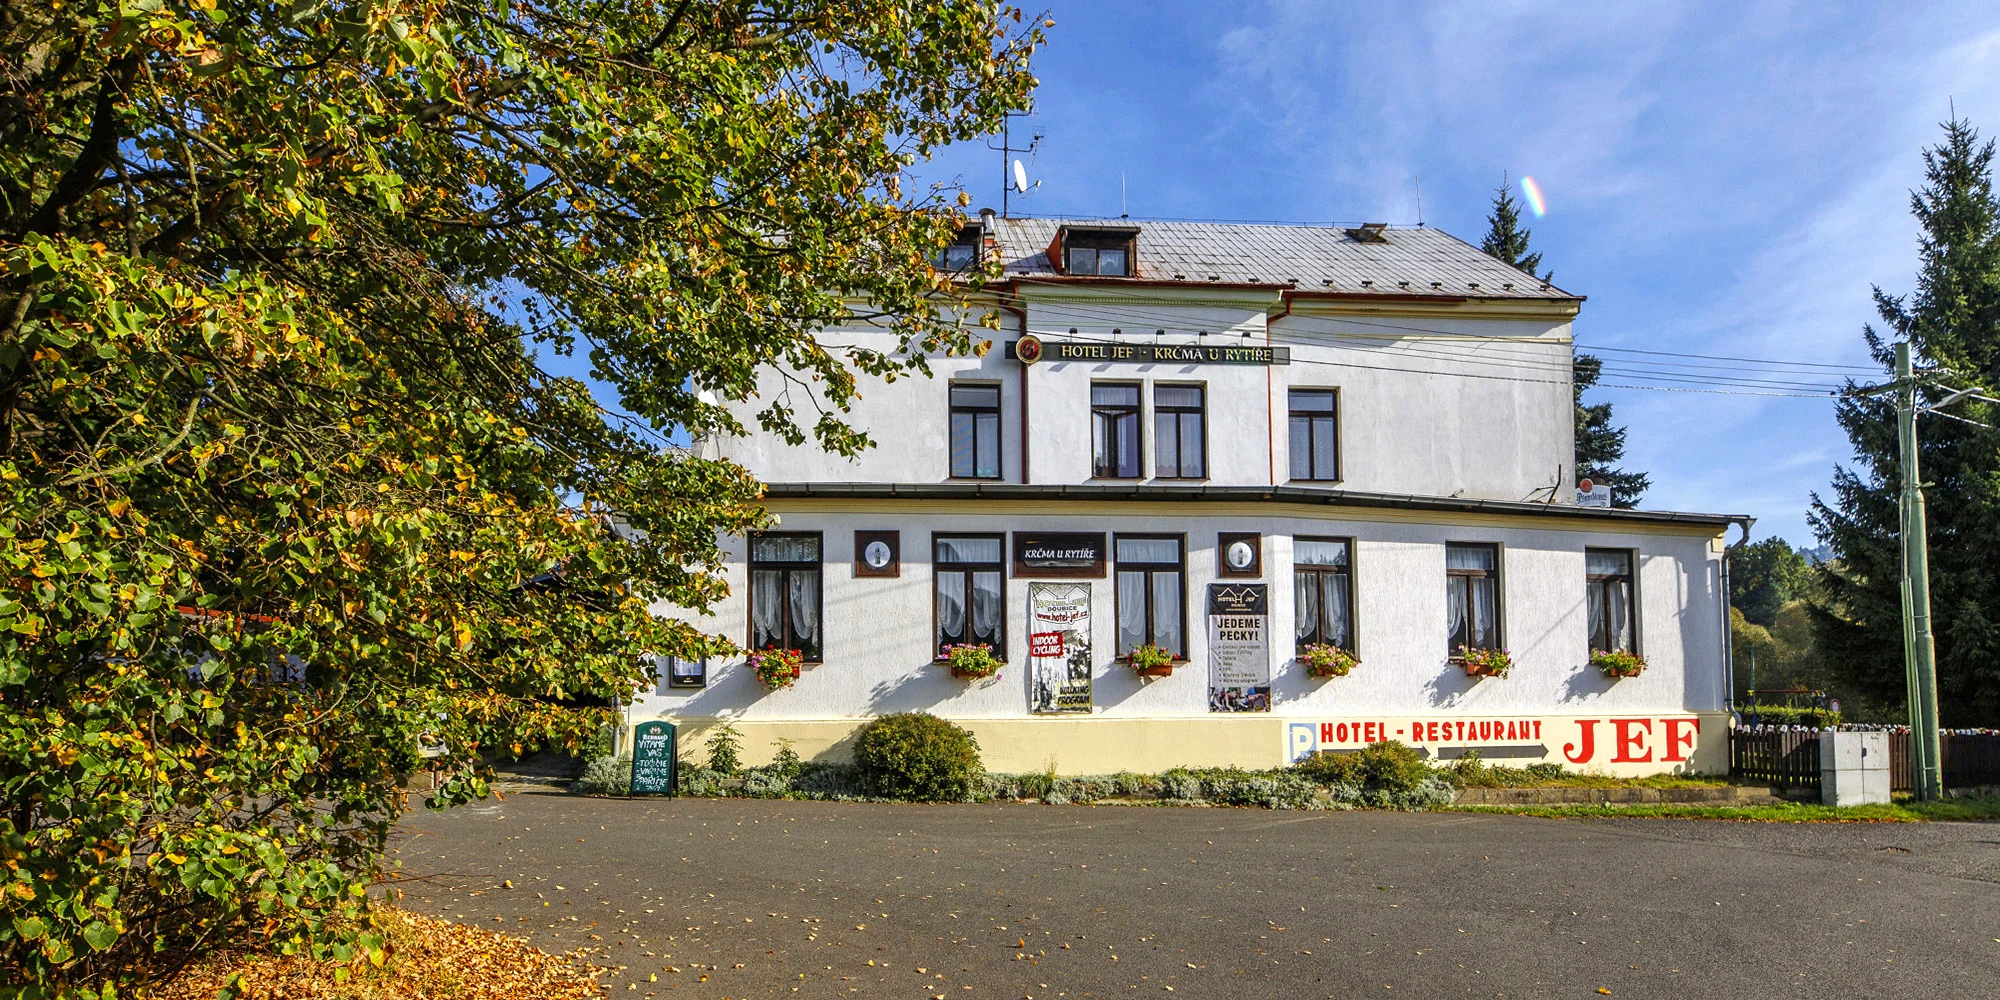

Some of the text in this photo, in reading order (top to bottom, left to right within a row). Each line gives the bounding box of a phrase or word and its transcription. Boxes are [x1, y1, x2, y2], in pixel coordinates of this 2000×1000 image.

[1061, 345, 1107, 358] HOTEL
[1112, 346, 1133, 359] JEF
[1154, 345, 1203, 360] KRČMA
[1209, 349, 1219, 360] U
[1225, 347, 1271, 361] RYTÍŘE
[1025, 548, 1094, 559] KRČMA U RYTÍŘE
[1037, 611, 1087, 622] www.hotel-jef.cz
[1217, 618, 1260, 629] JEDEME
[1033, 635, 1059, 646] INDOOR
[1220, 630, 1258, 641] PECKY!
[1033, 645, 1061, 655] CYCLING
[1057, 695, 1090, 705] PROGRAM
[1321, 722, 1388, 743] HOTEL
[1412, 720, 1542, 742] RESTAURANT
[1563, 719, 1700, 764] JEF
